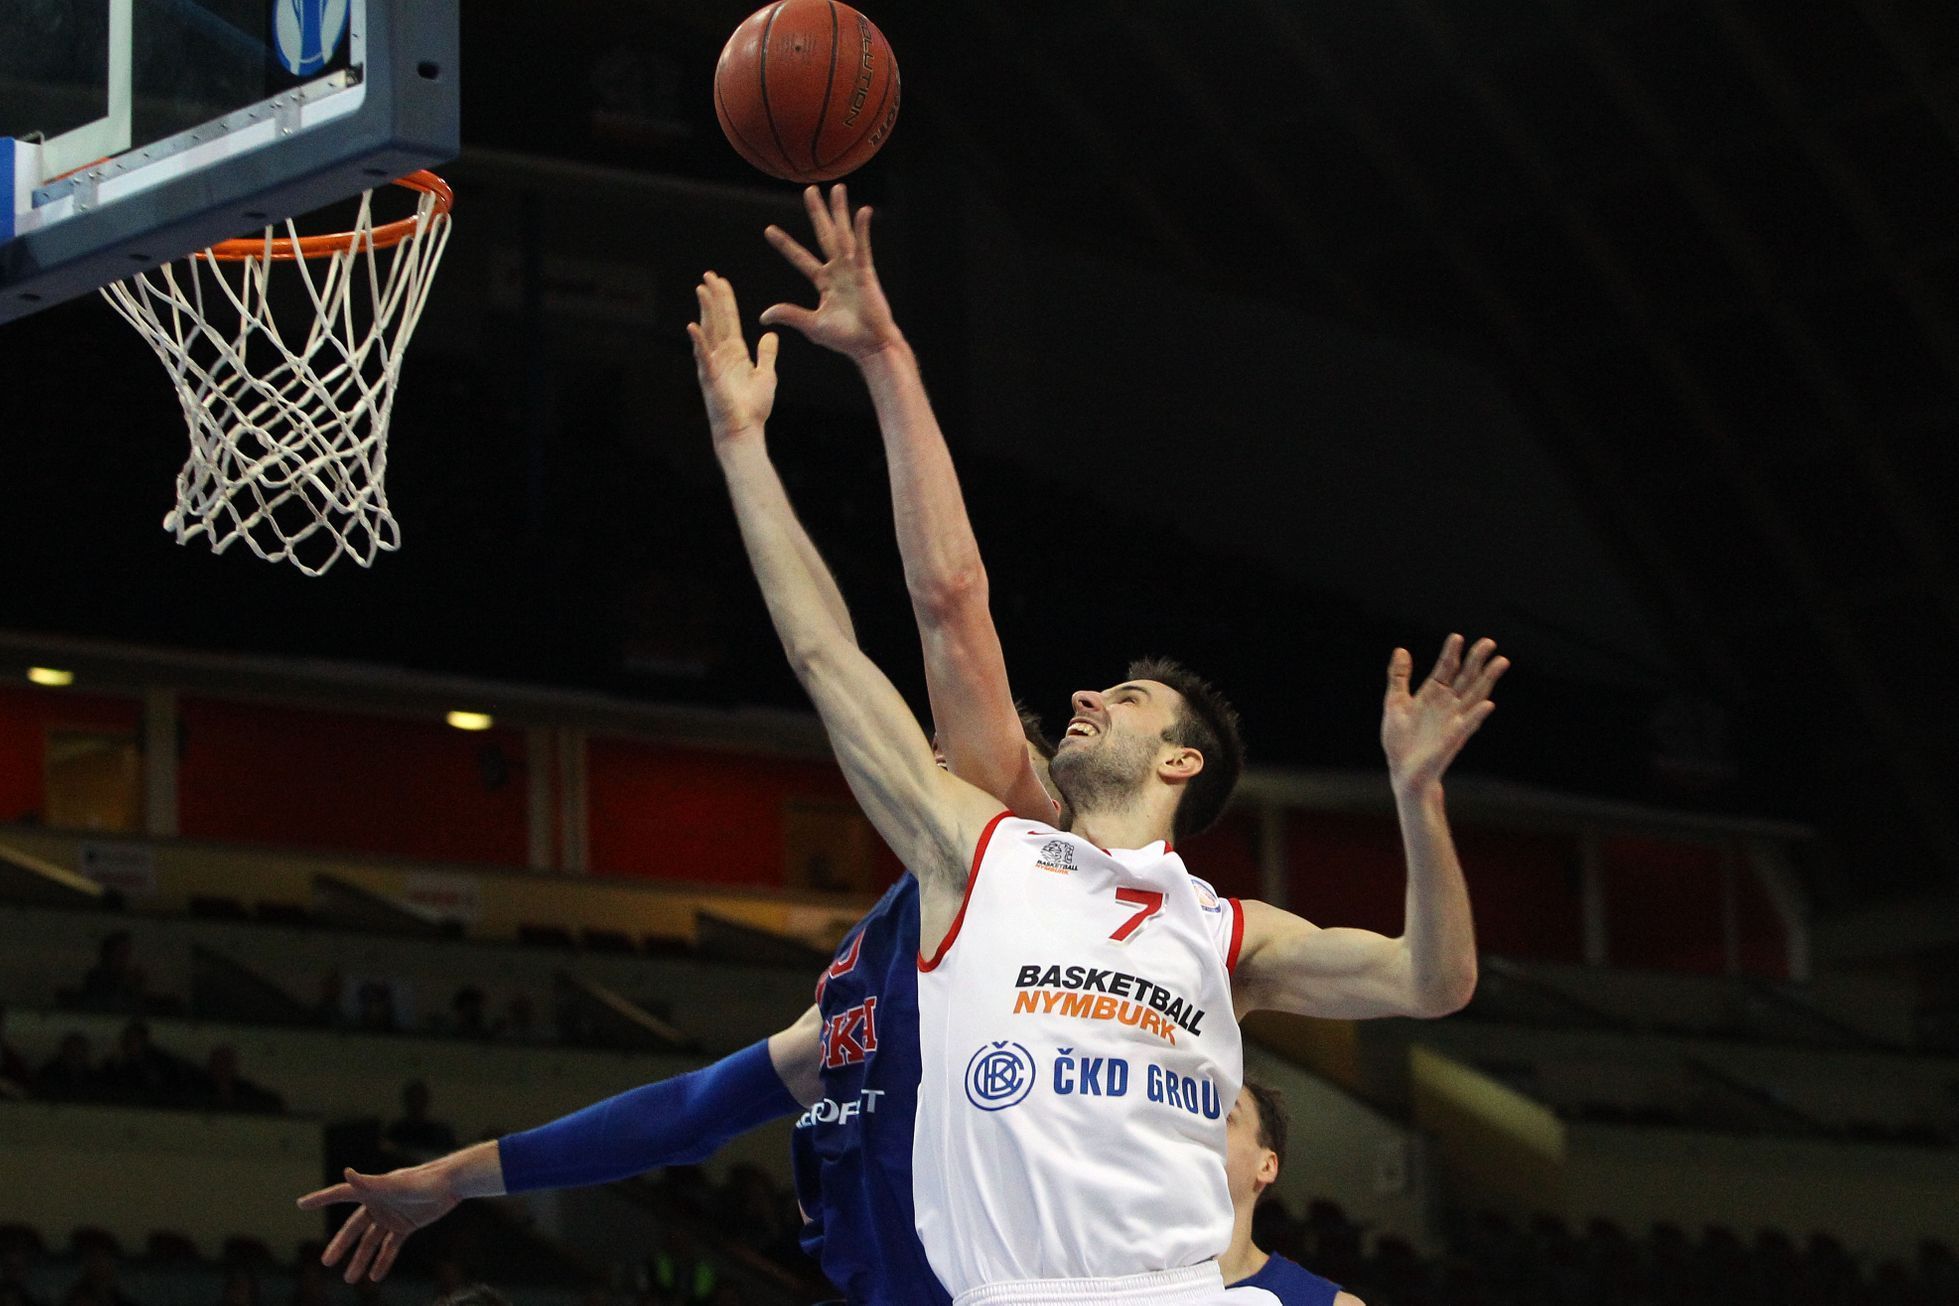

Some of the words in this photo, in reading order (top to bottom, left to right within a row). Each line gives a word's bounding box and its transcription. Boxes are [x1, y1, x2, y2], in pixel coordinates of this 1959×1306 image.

[1108, 886, 1168, 945] 7
[1013, 991, 1176, 1046] NYMBURK
[1015, 965, 1205, 1036] BASKETBALL
[1053, 1048, 1129, 1097] ČKD
